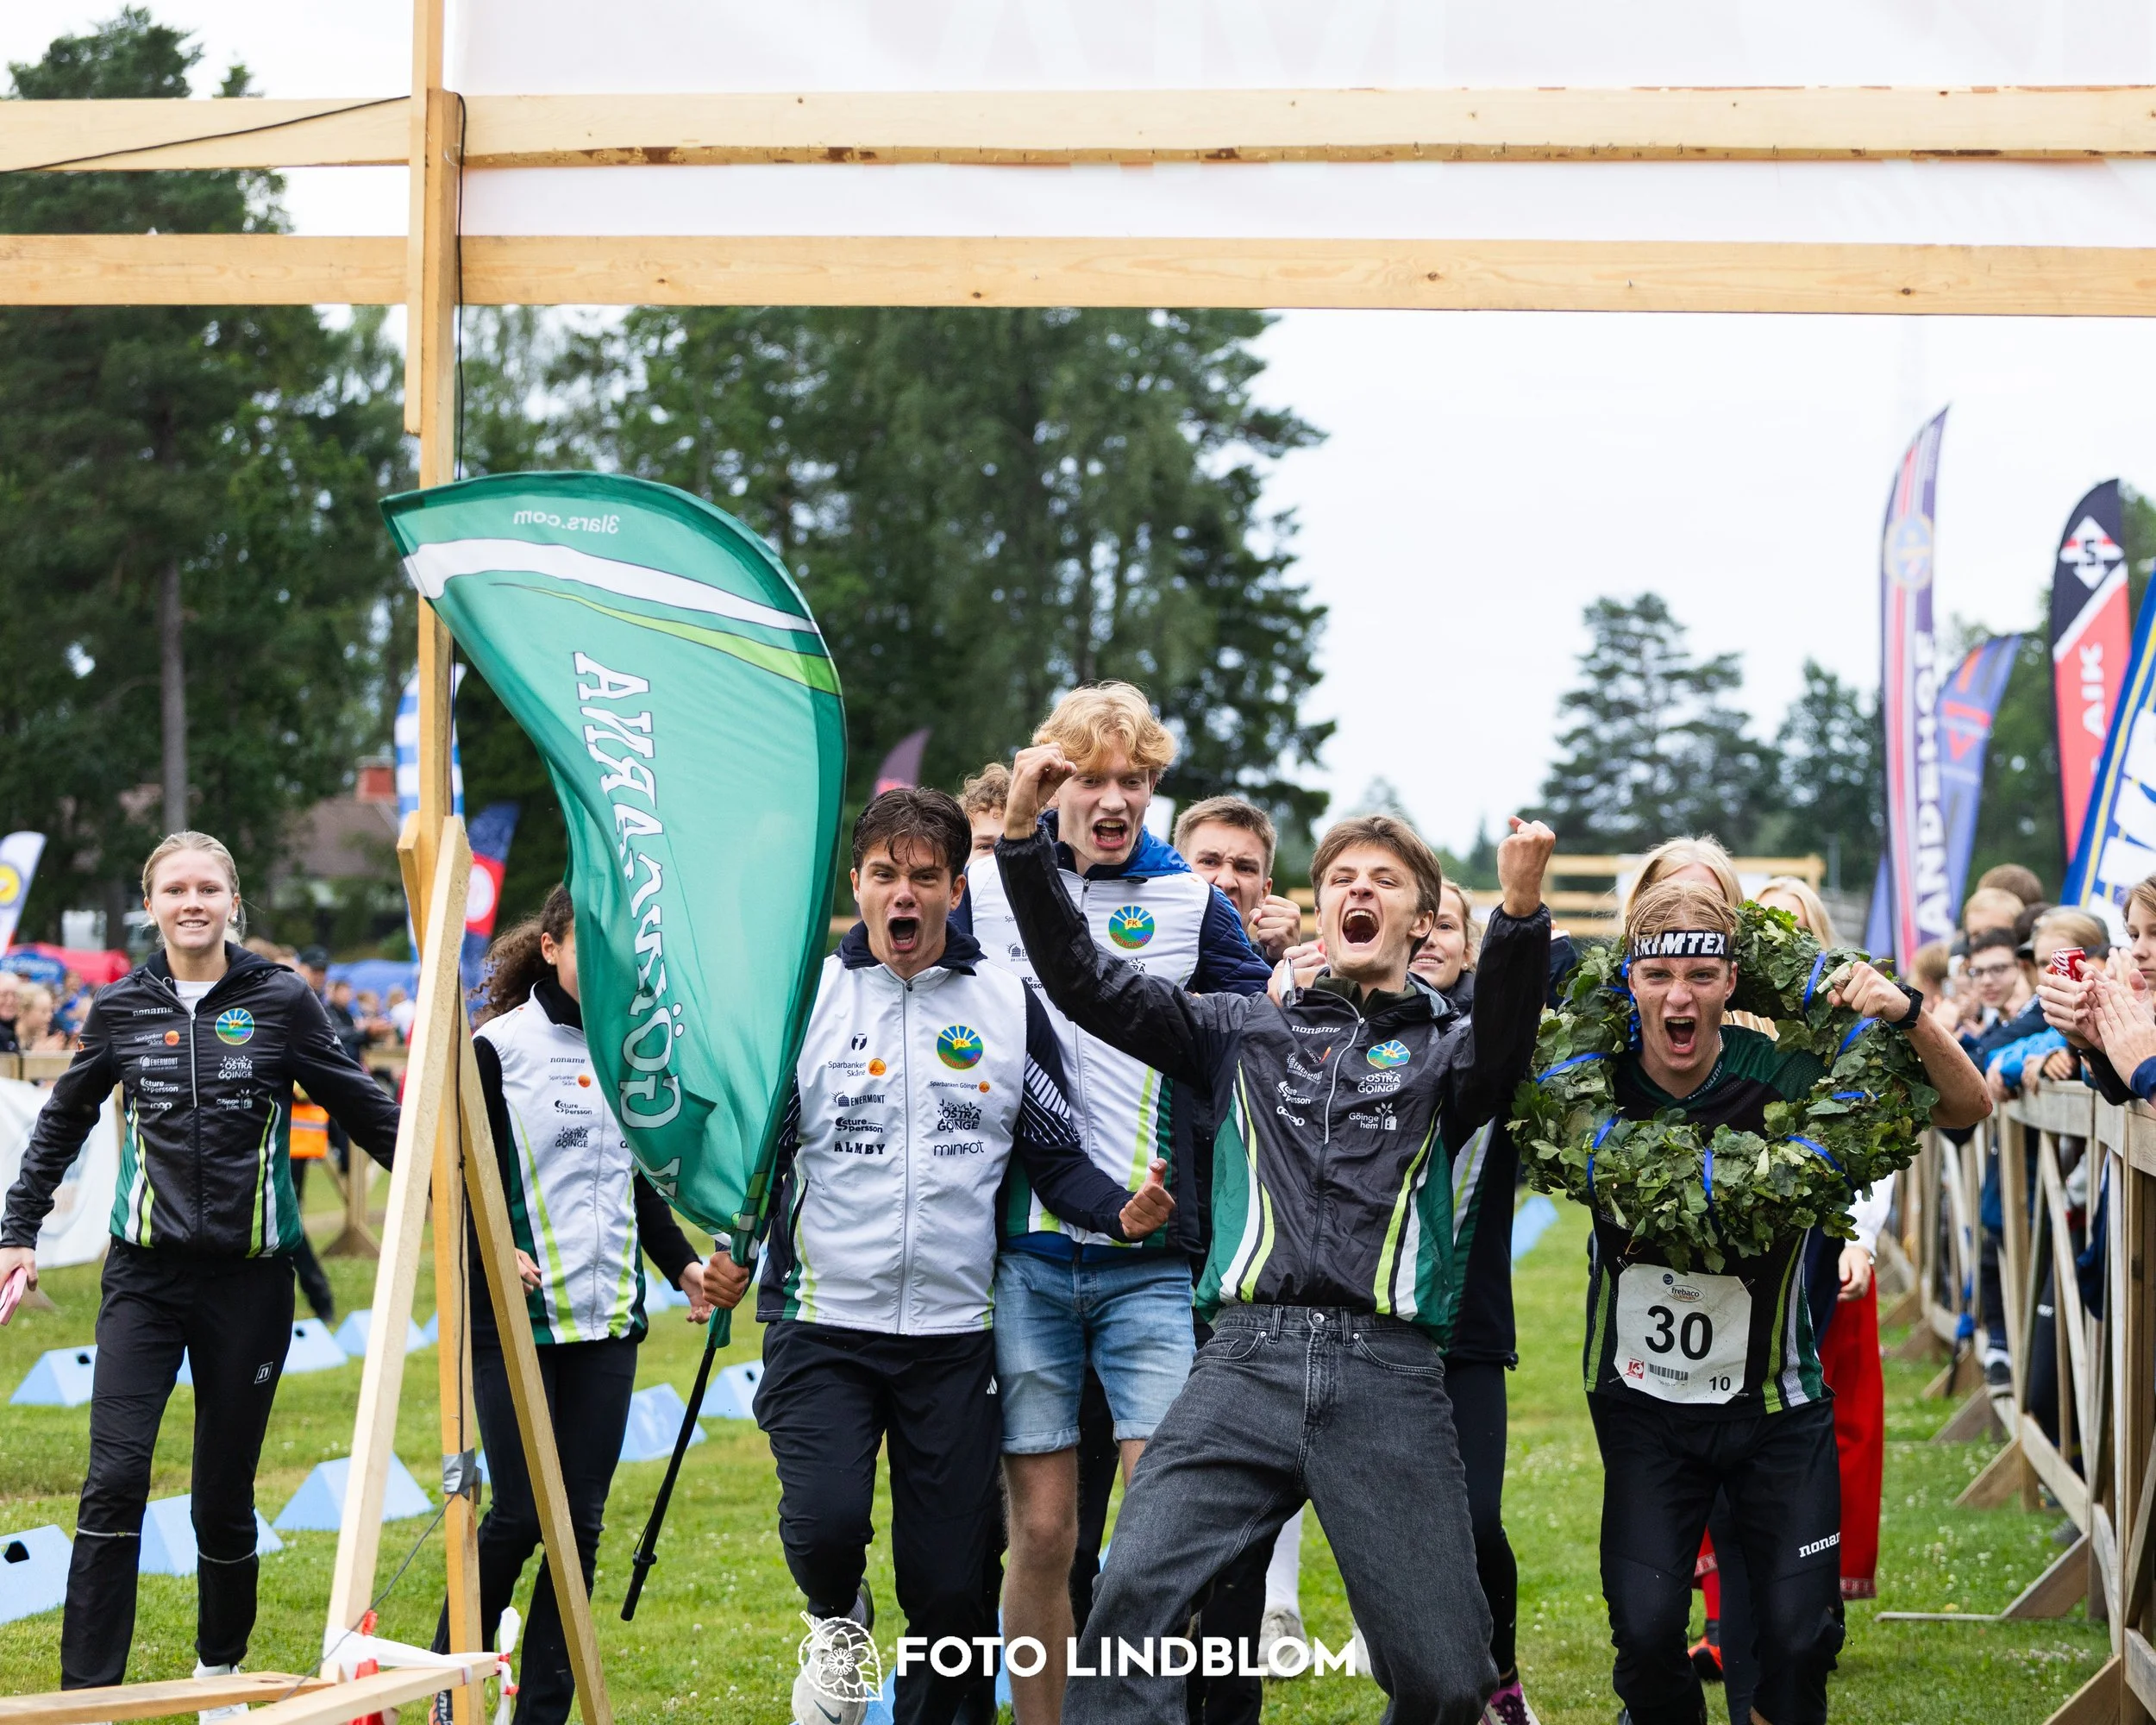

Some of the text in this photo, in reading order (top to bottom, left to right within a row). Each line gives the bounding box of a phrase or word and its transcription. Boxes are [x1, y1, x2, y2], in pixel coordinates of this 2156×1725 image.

[1112, 932, 1151, 947] GÖINGARNA
[133, 1007, 173, 1017] noname
[1292, 1025, 1341, 1034] noname
[850, 1095, 886, 1107] ENERMONT
[1349, 1113, 1379, 1123] Göinge
[834, 1140, 886, 1155] ÄLMBY
[1671, 1286, 1700, 1297] frebaco
[1645, 1305, 1714, 1361] 30
[1708, 1377, 1731, 1391] 10
[1798, 1532, 1840, 1558] nona
